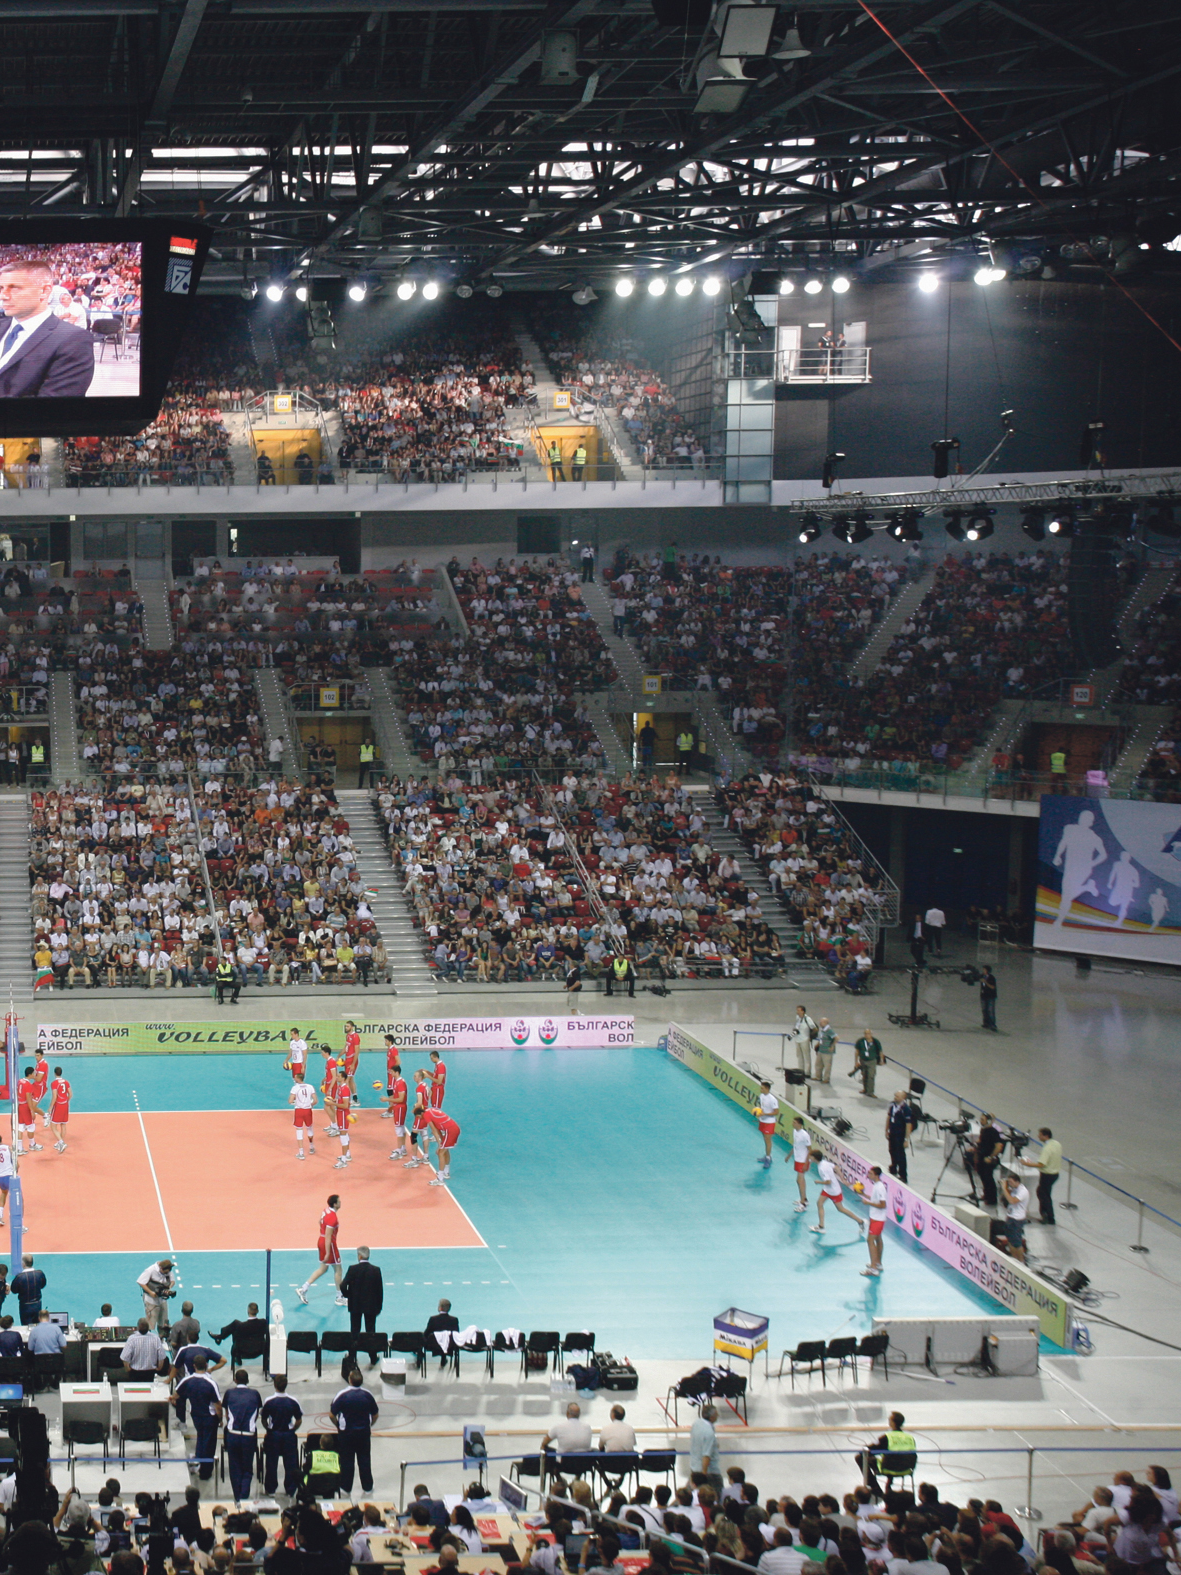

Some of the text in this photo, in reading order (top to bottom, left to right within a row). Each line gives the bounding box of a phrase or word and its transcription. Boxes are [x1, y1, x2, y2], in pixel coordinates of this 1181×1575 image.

[50, 1028, 129, 1039] ФЕДЕРАЦИЯ
[344, 1023, 420, 1034] ЪЛГАРСКА
[423, 1022, 502, 1034] ФЕДЕРАЦИЯ
[393, 1034, 455, 1046] ОЛЕЙБОЛ
[60, 1083, 66, 1094] 3
[301, 1089, 307, 1098] 4
[931, 1216, 1058, 1319] БЪЛГАРСКА ФЕДЕРАЦИЯ
[960, 1255, 1017, 1308] ВОЛЕЙБОЛ
